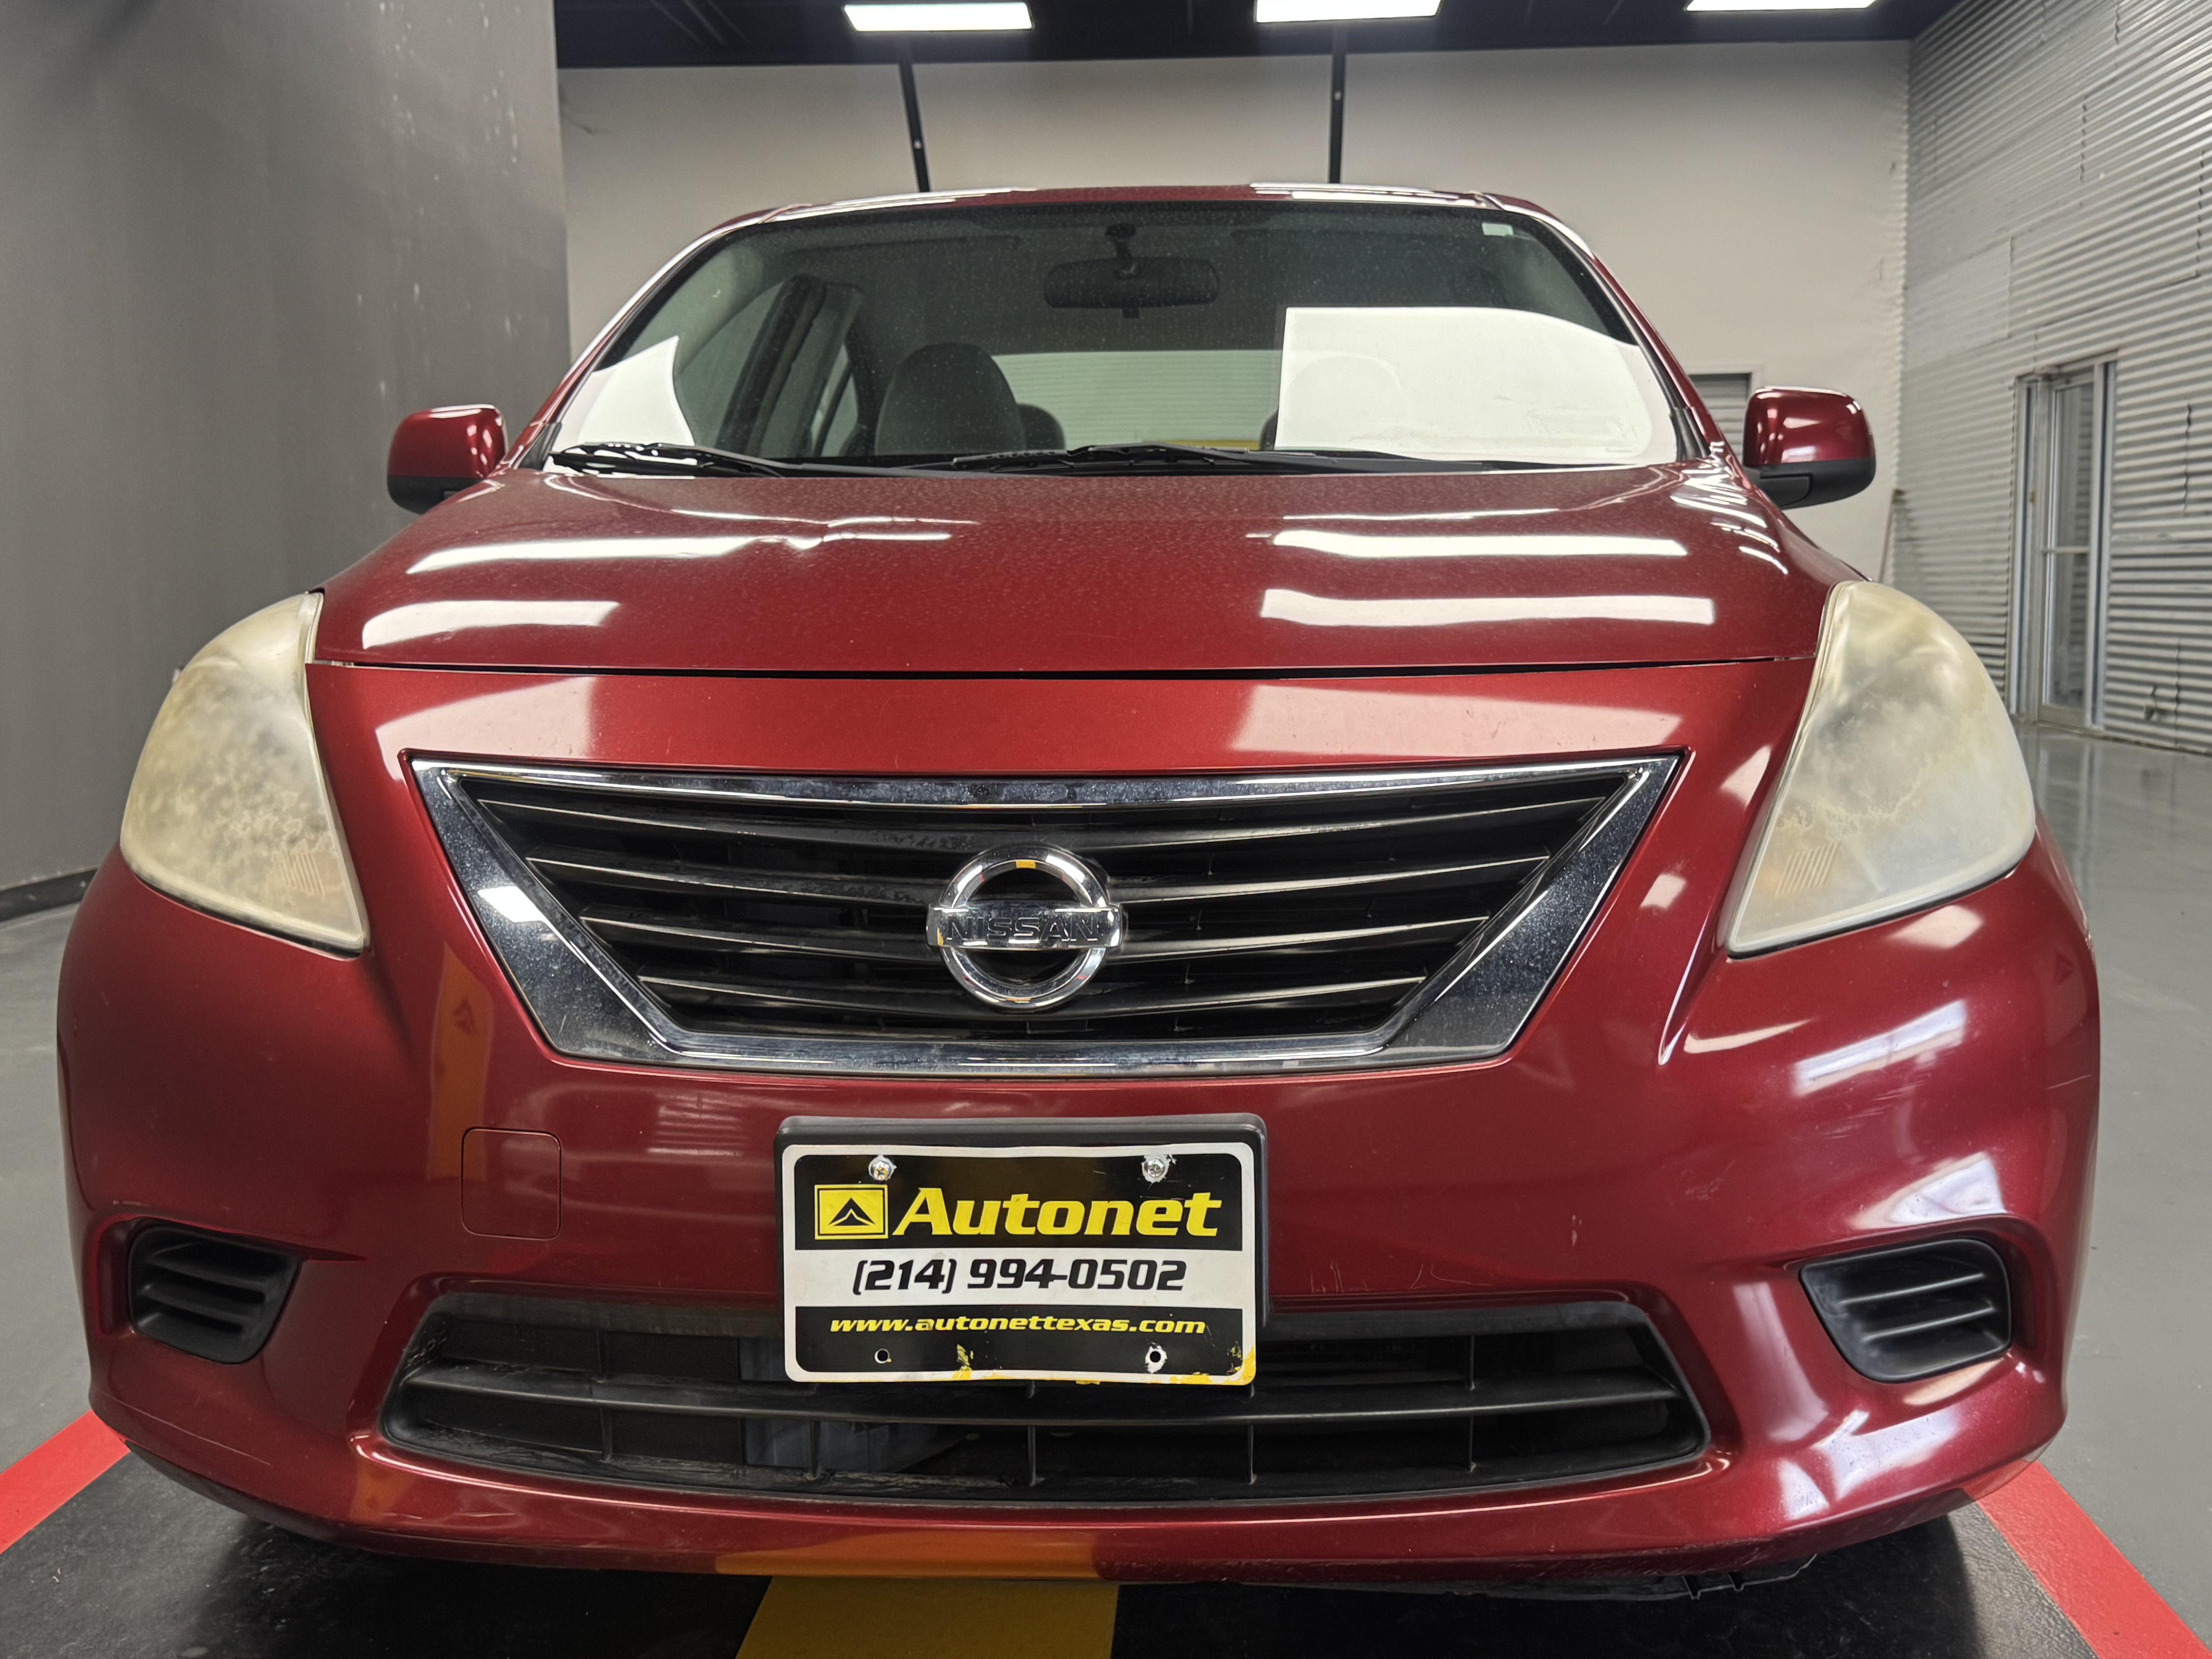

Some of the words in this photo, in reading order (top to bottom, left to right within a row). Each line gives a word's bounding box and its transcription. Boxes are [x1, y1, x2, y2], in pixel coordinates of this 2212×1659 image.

[946, 916, 1098, 942] NISSAN
[893, 1188, 1223, 1237] Autonet
[853, 1259, 957, 1295] (214)
[967, 1259, 1187, 1291] 994-0502
[831, 1316, 1206, 1334] www.autonettexas.com
